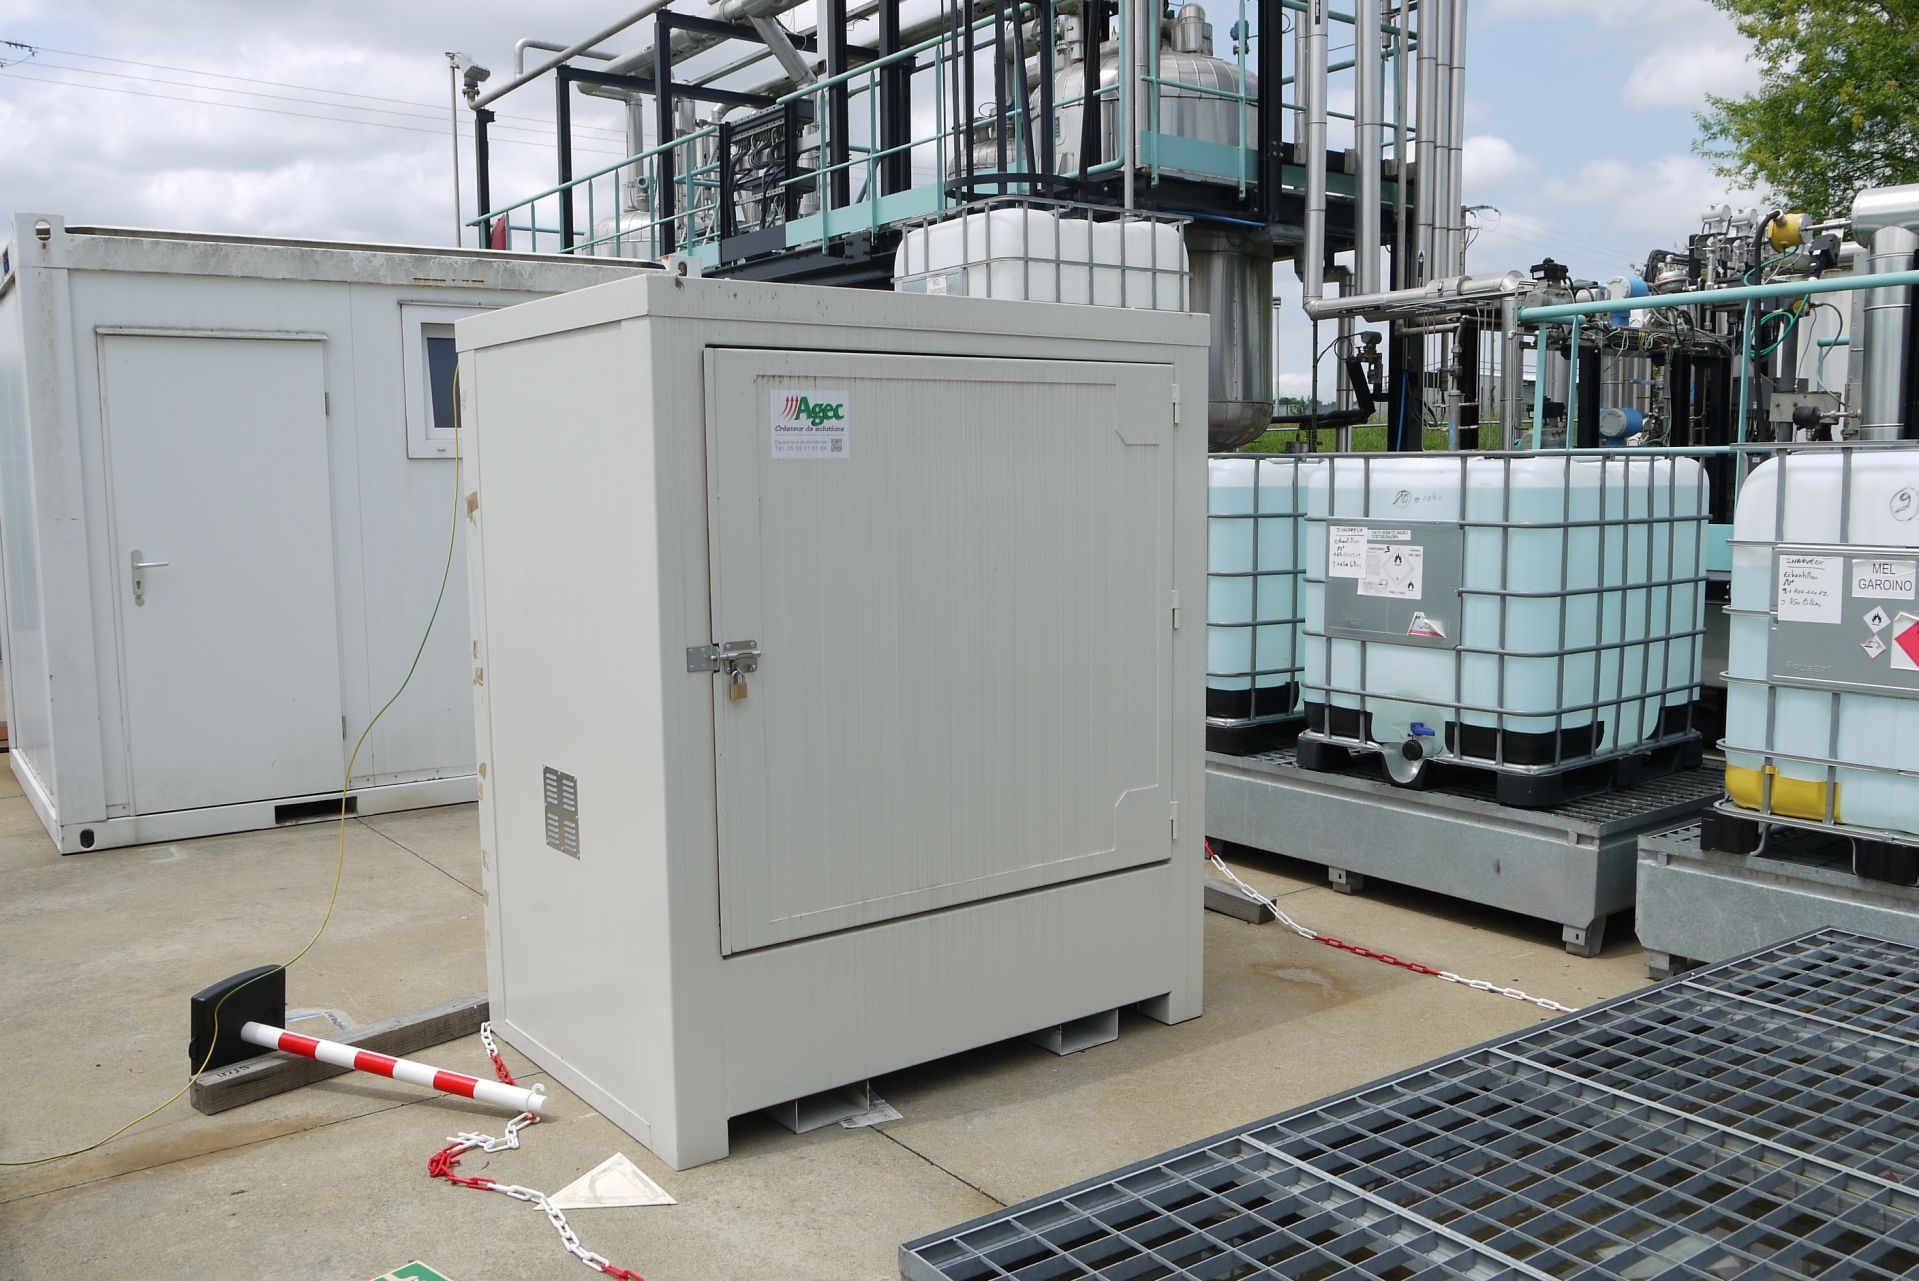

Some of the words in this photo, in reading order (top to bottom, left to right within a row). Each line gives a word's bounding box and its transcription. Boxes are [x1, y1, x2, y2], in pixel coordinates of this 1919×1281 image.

[795, 396, 844, 426] Agec
[1872, 562, 1896, 575] MEL
[1858, 578, 1913, 592] GAROINO
